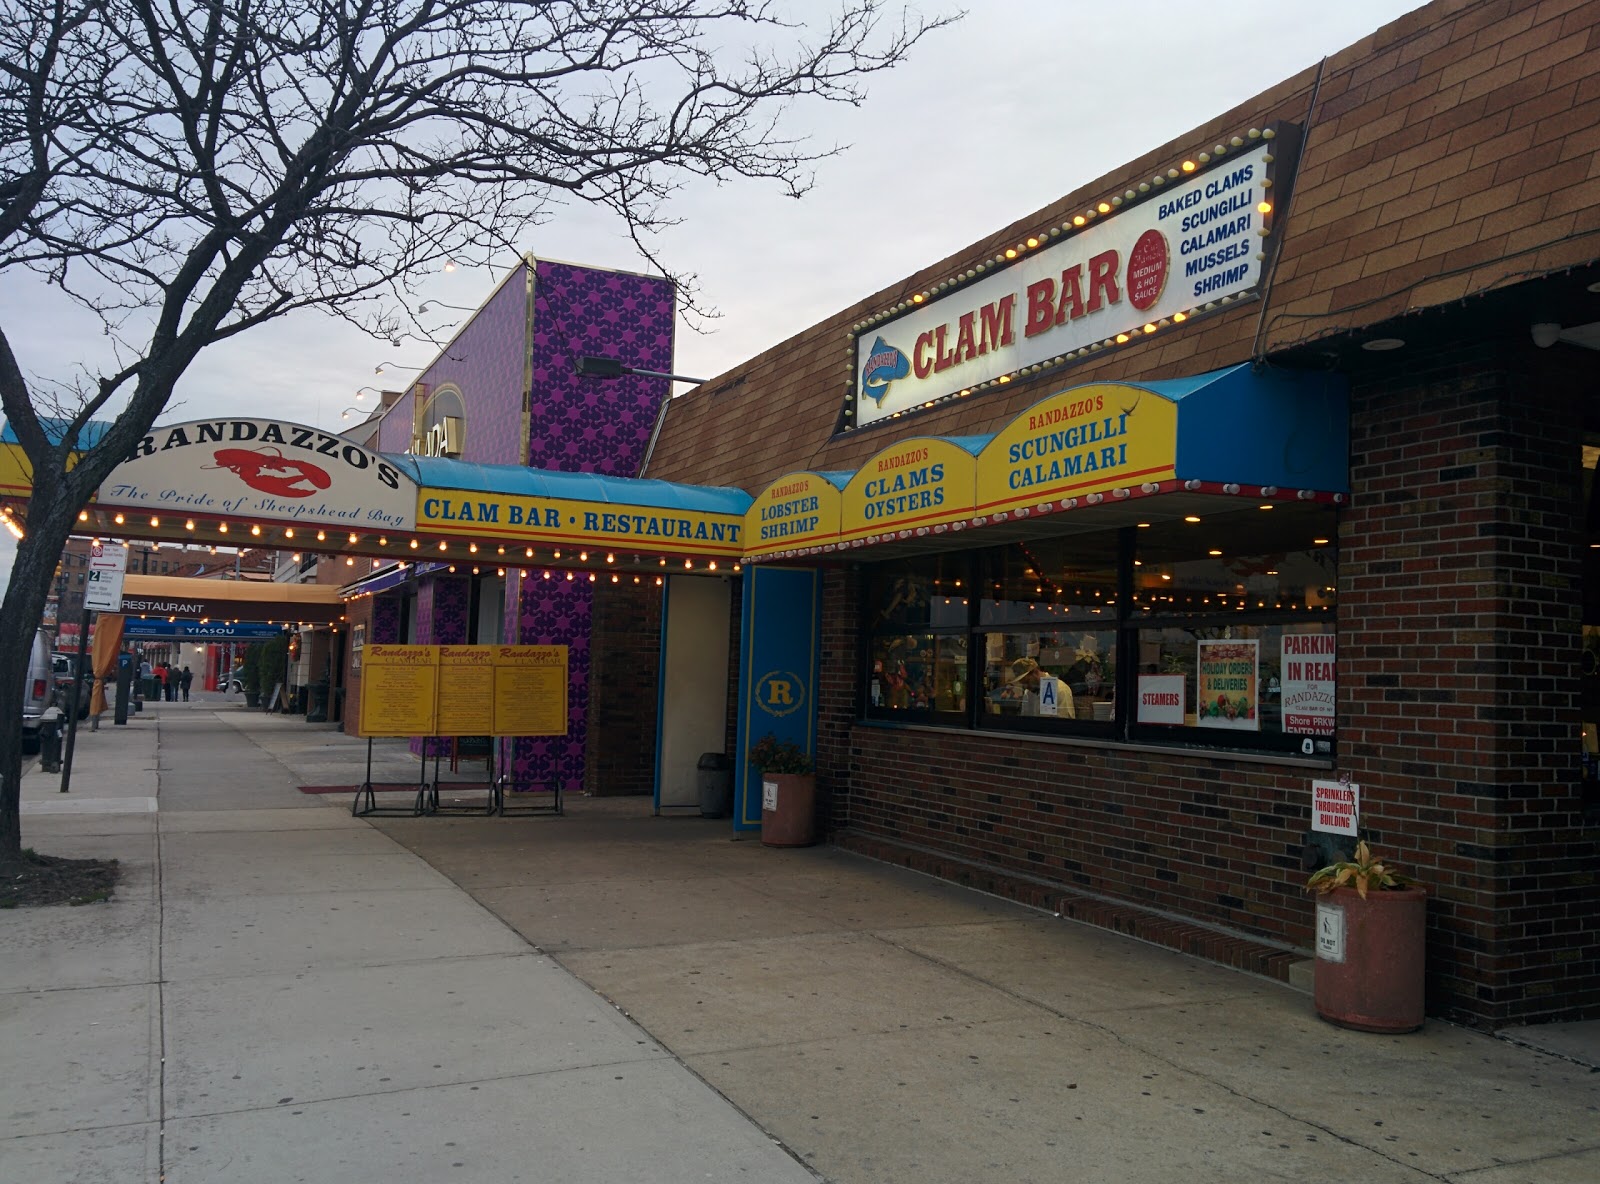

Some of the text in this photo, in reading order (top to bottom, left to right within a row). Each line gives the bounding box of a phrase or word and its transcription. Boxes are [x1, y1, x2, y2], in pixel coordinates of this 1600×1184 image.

[1158, 164, 1254, 221] BAKED CLAMS
[1181, 188, 1253, 233] SCUNGILLI
[1180, 213, 1252, 256] CALAMARI
[1185, 238, 1250, 278] MUSSELS
[1132, 261, 1163, 279] MEDIUM
[1193, 263, 1250, 297] SHRIMP
[1134, 285, 1158, 302] SAUCE
[1136, 274, 1158, 290] & HOT
[913, 248, 1124, 380] CLAM BAR
[1028, 395, 1104, 431] RANDAZZO'S
[1008, 413, 1128, 465] SCUNGILLI
[124, 420, 400, 490] RANDAZZO'S
[877, 448, 929, 473] RANDAZZO'S
[1008, 443, 1128, 490] CALAMARI
[771, 480, 809, 499] RANDAZZO'S
[864, 463, 945, 499] CLAMS
[110, 485, 405, 528] The Pride of Sheepshead Bay
[760, 495, 819, 522] LOBSTER
[864, 486, 945, 520] OYSTERS
[423, 498, 741, 543] CLAM BAR RESTAURANT
[760, 516, 819, 540] SHRIMP
[91, 571, 99, 580] 2
[121, 600, 205, 613] RESTAURANT
[186, 627, 235, 635] YIASOU
[370, 646, 431, 660] Randazzo's
[499, 648, 560, 661] Randazzo's
[1284, 636, 1335, 655] PARKIN
[1202, 662, 1253, 675] HOLIDAY ORDERS
[1288, 662, 1302, 681] IN
[767, 680, 793, 705] R
[1043, 682, 1055, 704] A
[1213, 678, 1248, 691] DELIVERIES
[1142, 693, 1180, 706] STEAMERS
[1289, 715, 1311, 726] Shore
[1315, 787, 1355, 802] SPRINKLERS
[1319, 813, 1350, 828] BUILDING
